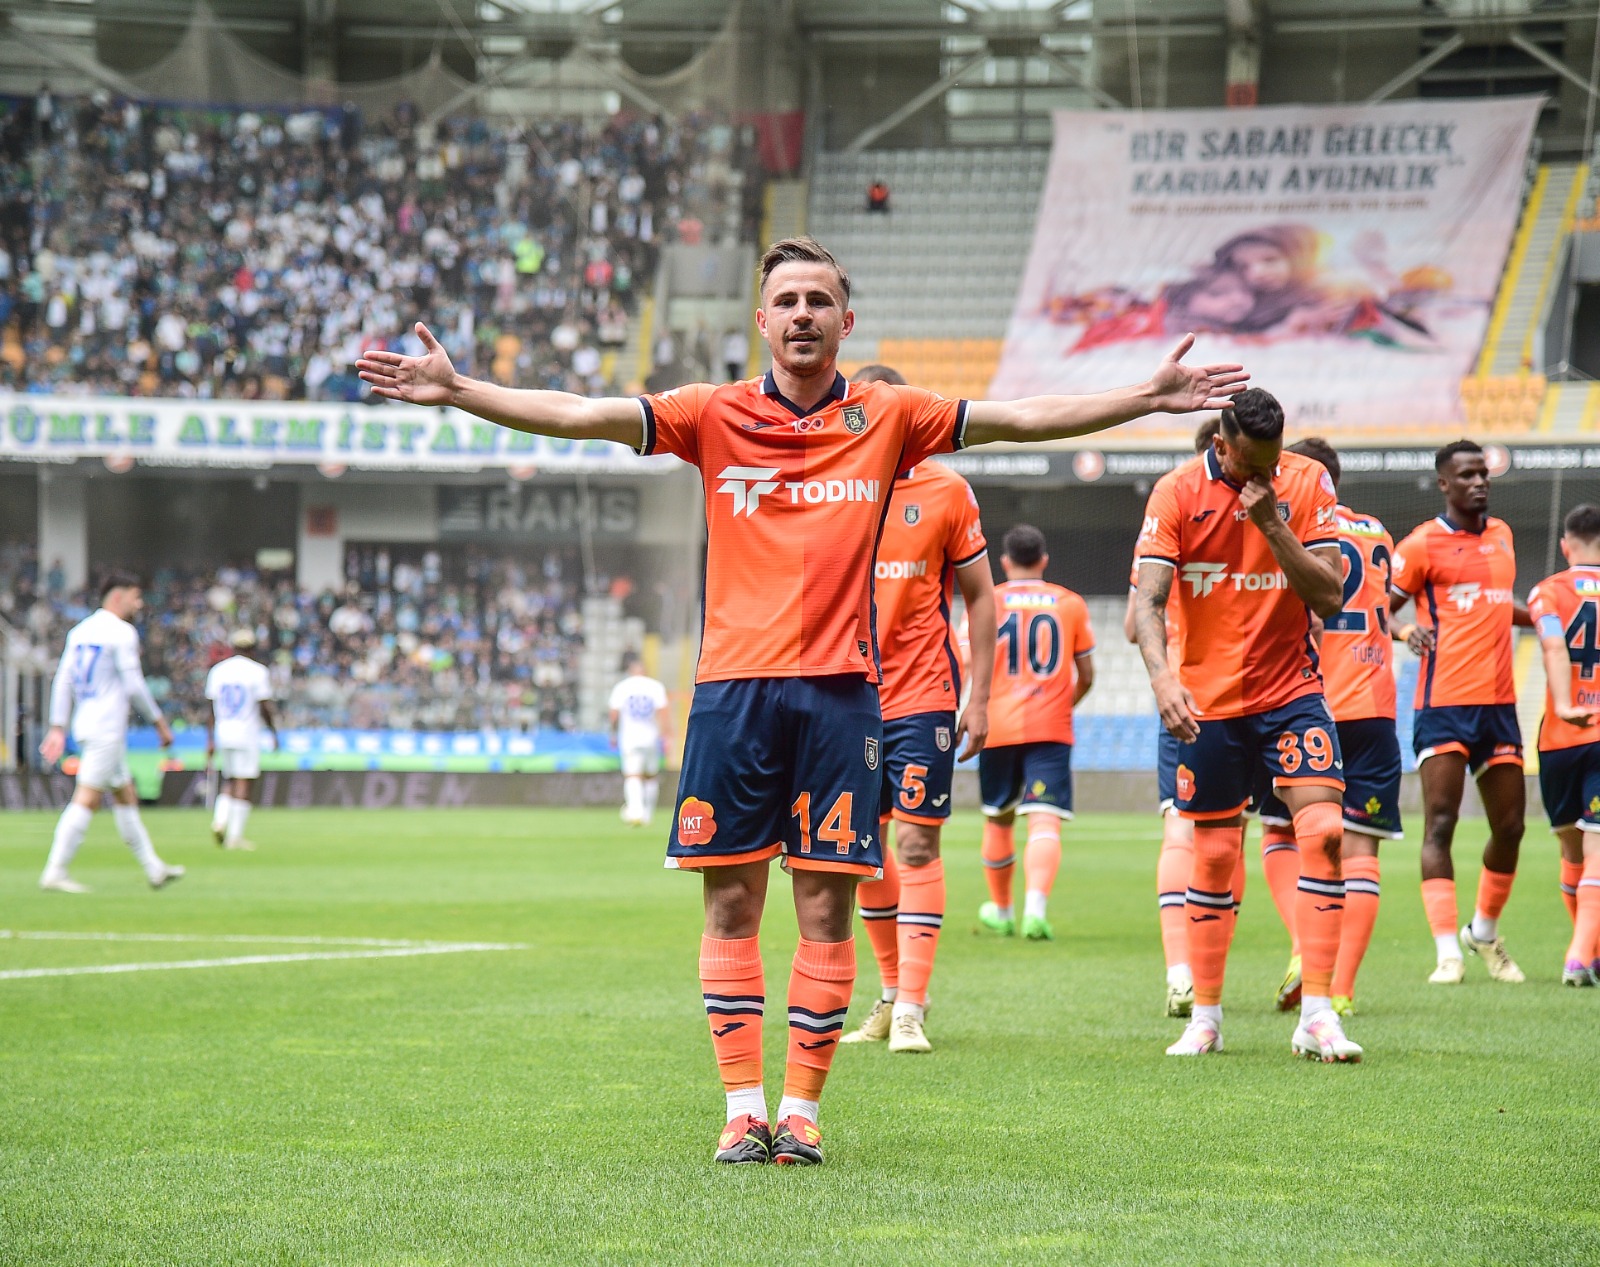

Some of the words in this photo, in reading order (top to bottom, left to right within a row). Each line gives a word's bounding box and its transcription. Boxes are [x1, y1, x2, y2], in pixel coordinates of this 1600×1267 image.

[0, 405, 158, 446] ÜMLE
[785, 479, 880, 504] TODINI
[875, 560, 927, 579] ODINI
[1231, 571, 1288, 591] TODI
[997, 611, 1061, 677] 10
[1276, 727, 1334, 773] 89
[899, 763, 928, 810] 5
[681, 816, 704, 831] YKT
[791, 791, 857, 855] 14
